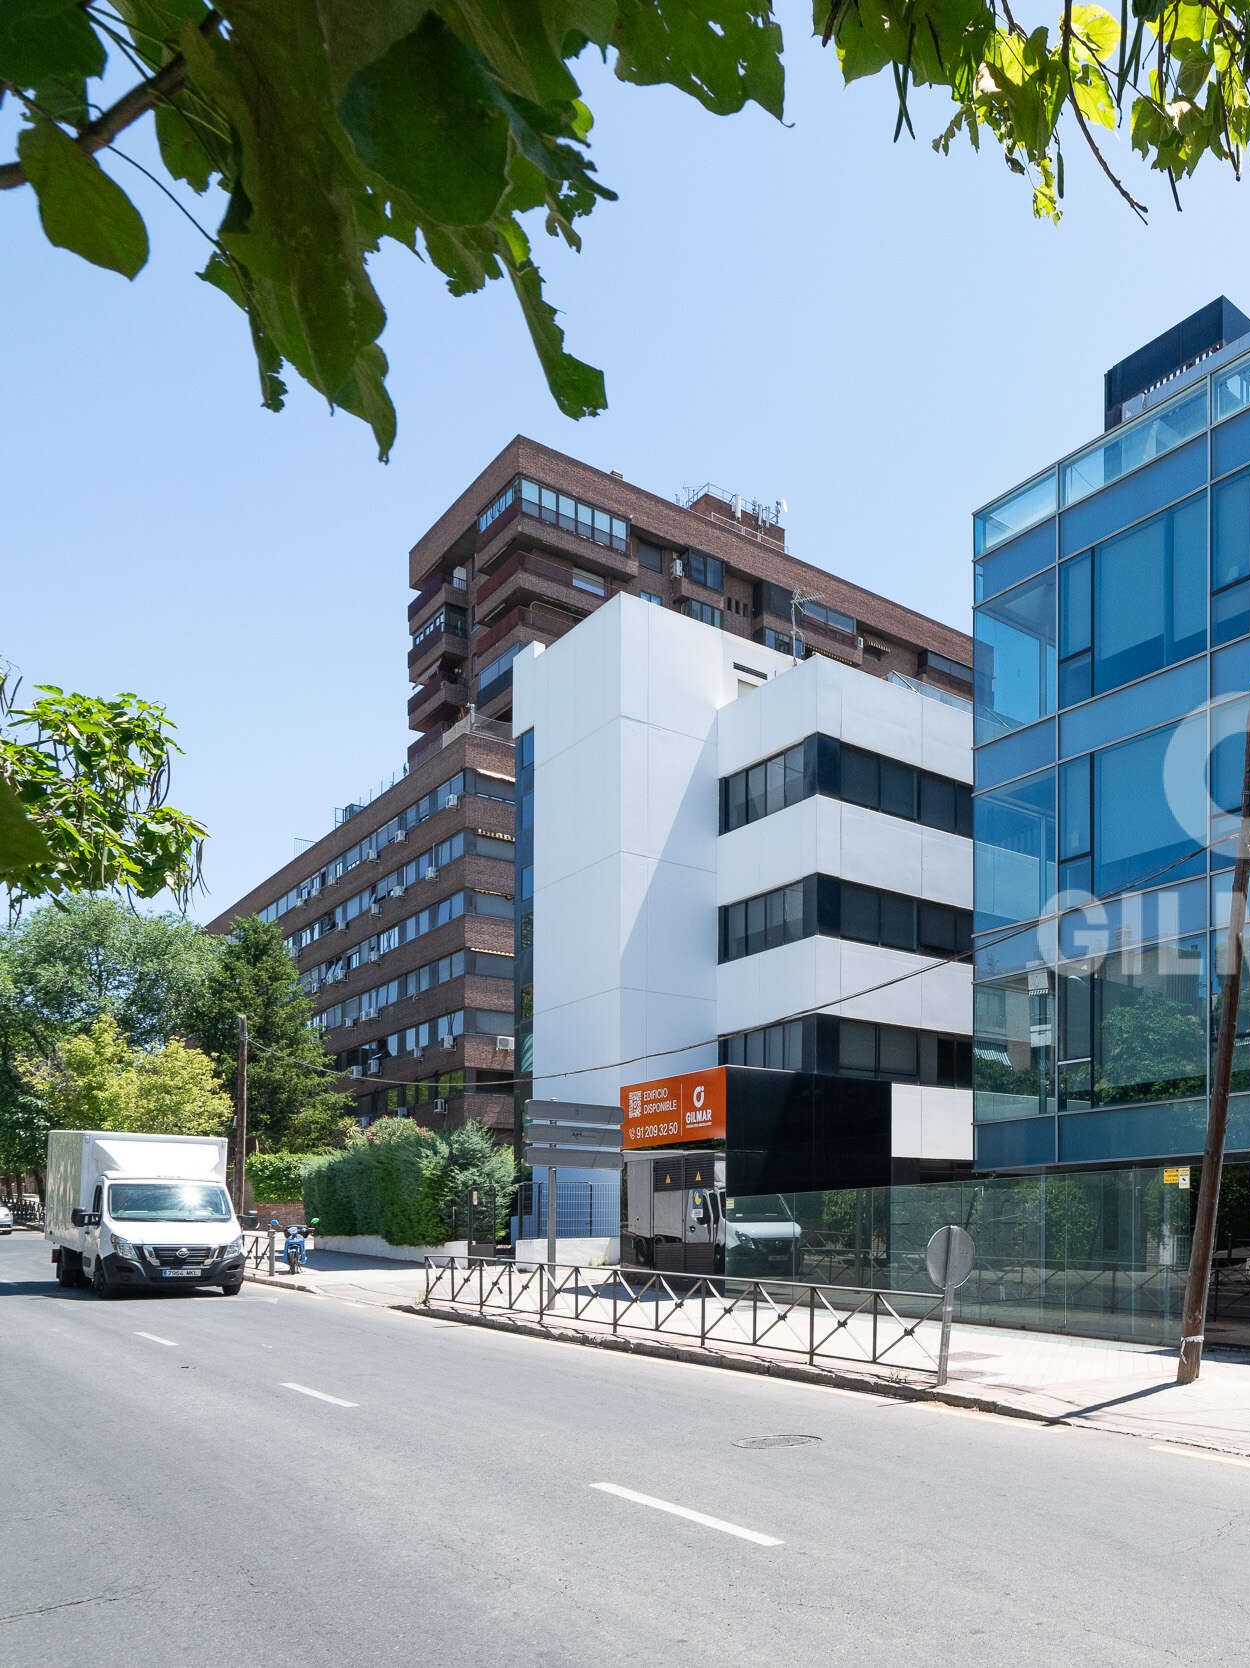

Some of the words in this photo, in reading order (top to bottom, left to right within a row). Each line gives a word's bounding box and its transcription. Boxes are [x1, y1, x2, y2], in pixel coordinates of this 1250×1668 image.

[643, 1087, 669, 1101] EDIFICIO
[643, 1099, 677, 1114] DISPONIBLE
[685, 1109, 712, 1124] GILMAR
[636, 1126, 644, 1139] 91
[645, 1124, 658, 1138] 209
[659, 1123, 668, 1136] 32
[668, 1121, 678, 1135] 50
